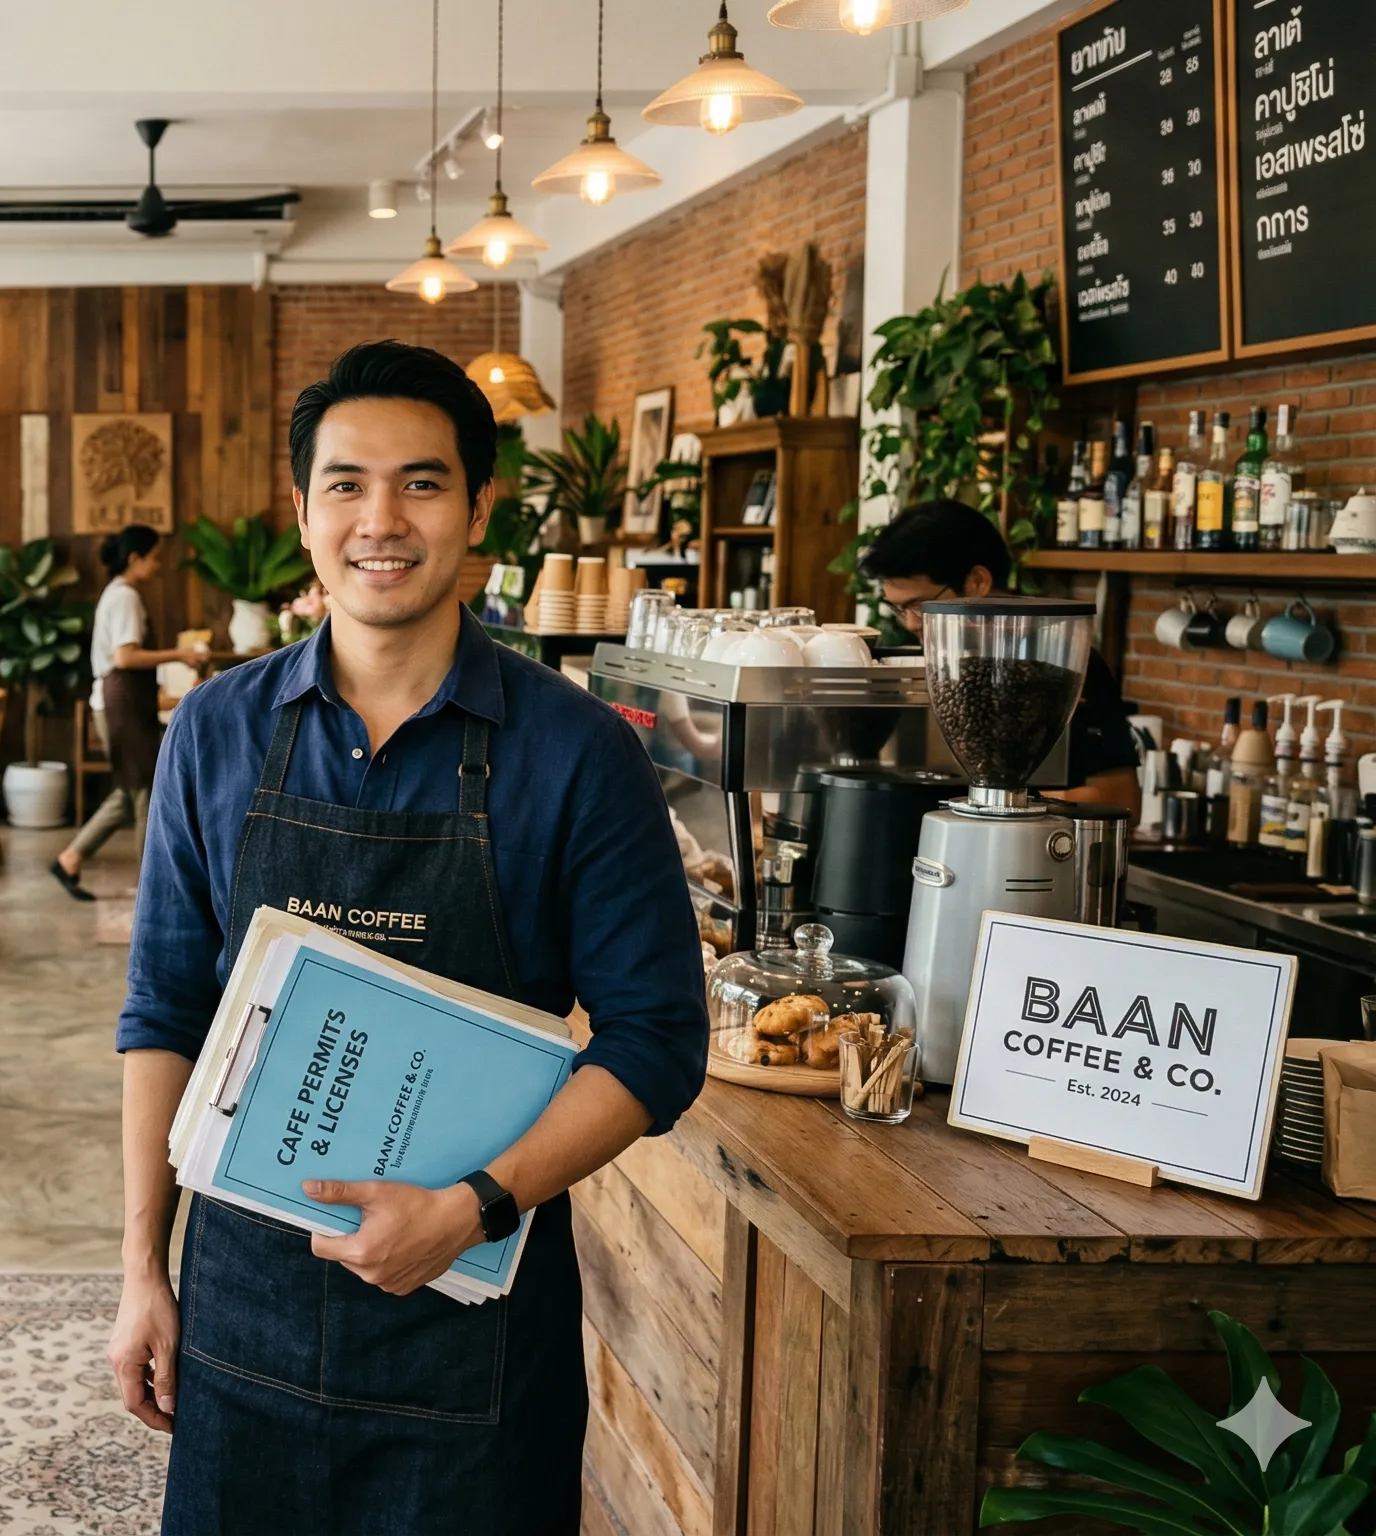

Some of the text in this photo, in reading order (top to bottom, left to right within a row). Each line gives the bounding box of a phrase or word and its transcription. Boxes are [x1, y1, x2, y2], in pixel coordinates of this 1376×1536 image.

[1254, 5, 1302, 59] ลาเต้
[1255, 57, 1334, 122] คาปูชิโน่
[1255, 109, 1365, 180] เอสเพรสโซ่
[1256, 205, 1309, 242] กการ
[1164, 268, 1178, 285] 40
[287, 896, 427, 930] BAAN COFFEE
[1021, 976, 1217, 1056] BAAN
[405, 1073, 418, 1084] &
[410, 1049, 426, 1070] CO.
[1003, 1030, 1222, 1096] COFFEE & CO.
[277, 1009, 346, 1165] CAFE PERMITS
[310, 1029, 368, 1156] & LICENSES
[388, 1084, 412, 1134] COFFEE
[1067, 1079, 1141, 1107] Est. 2024
[373, 1136, 396, 1176] BAAN
